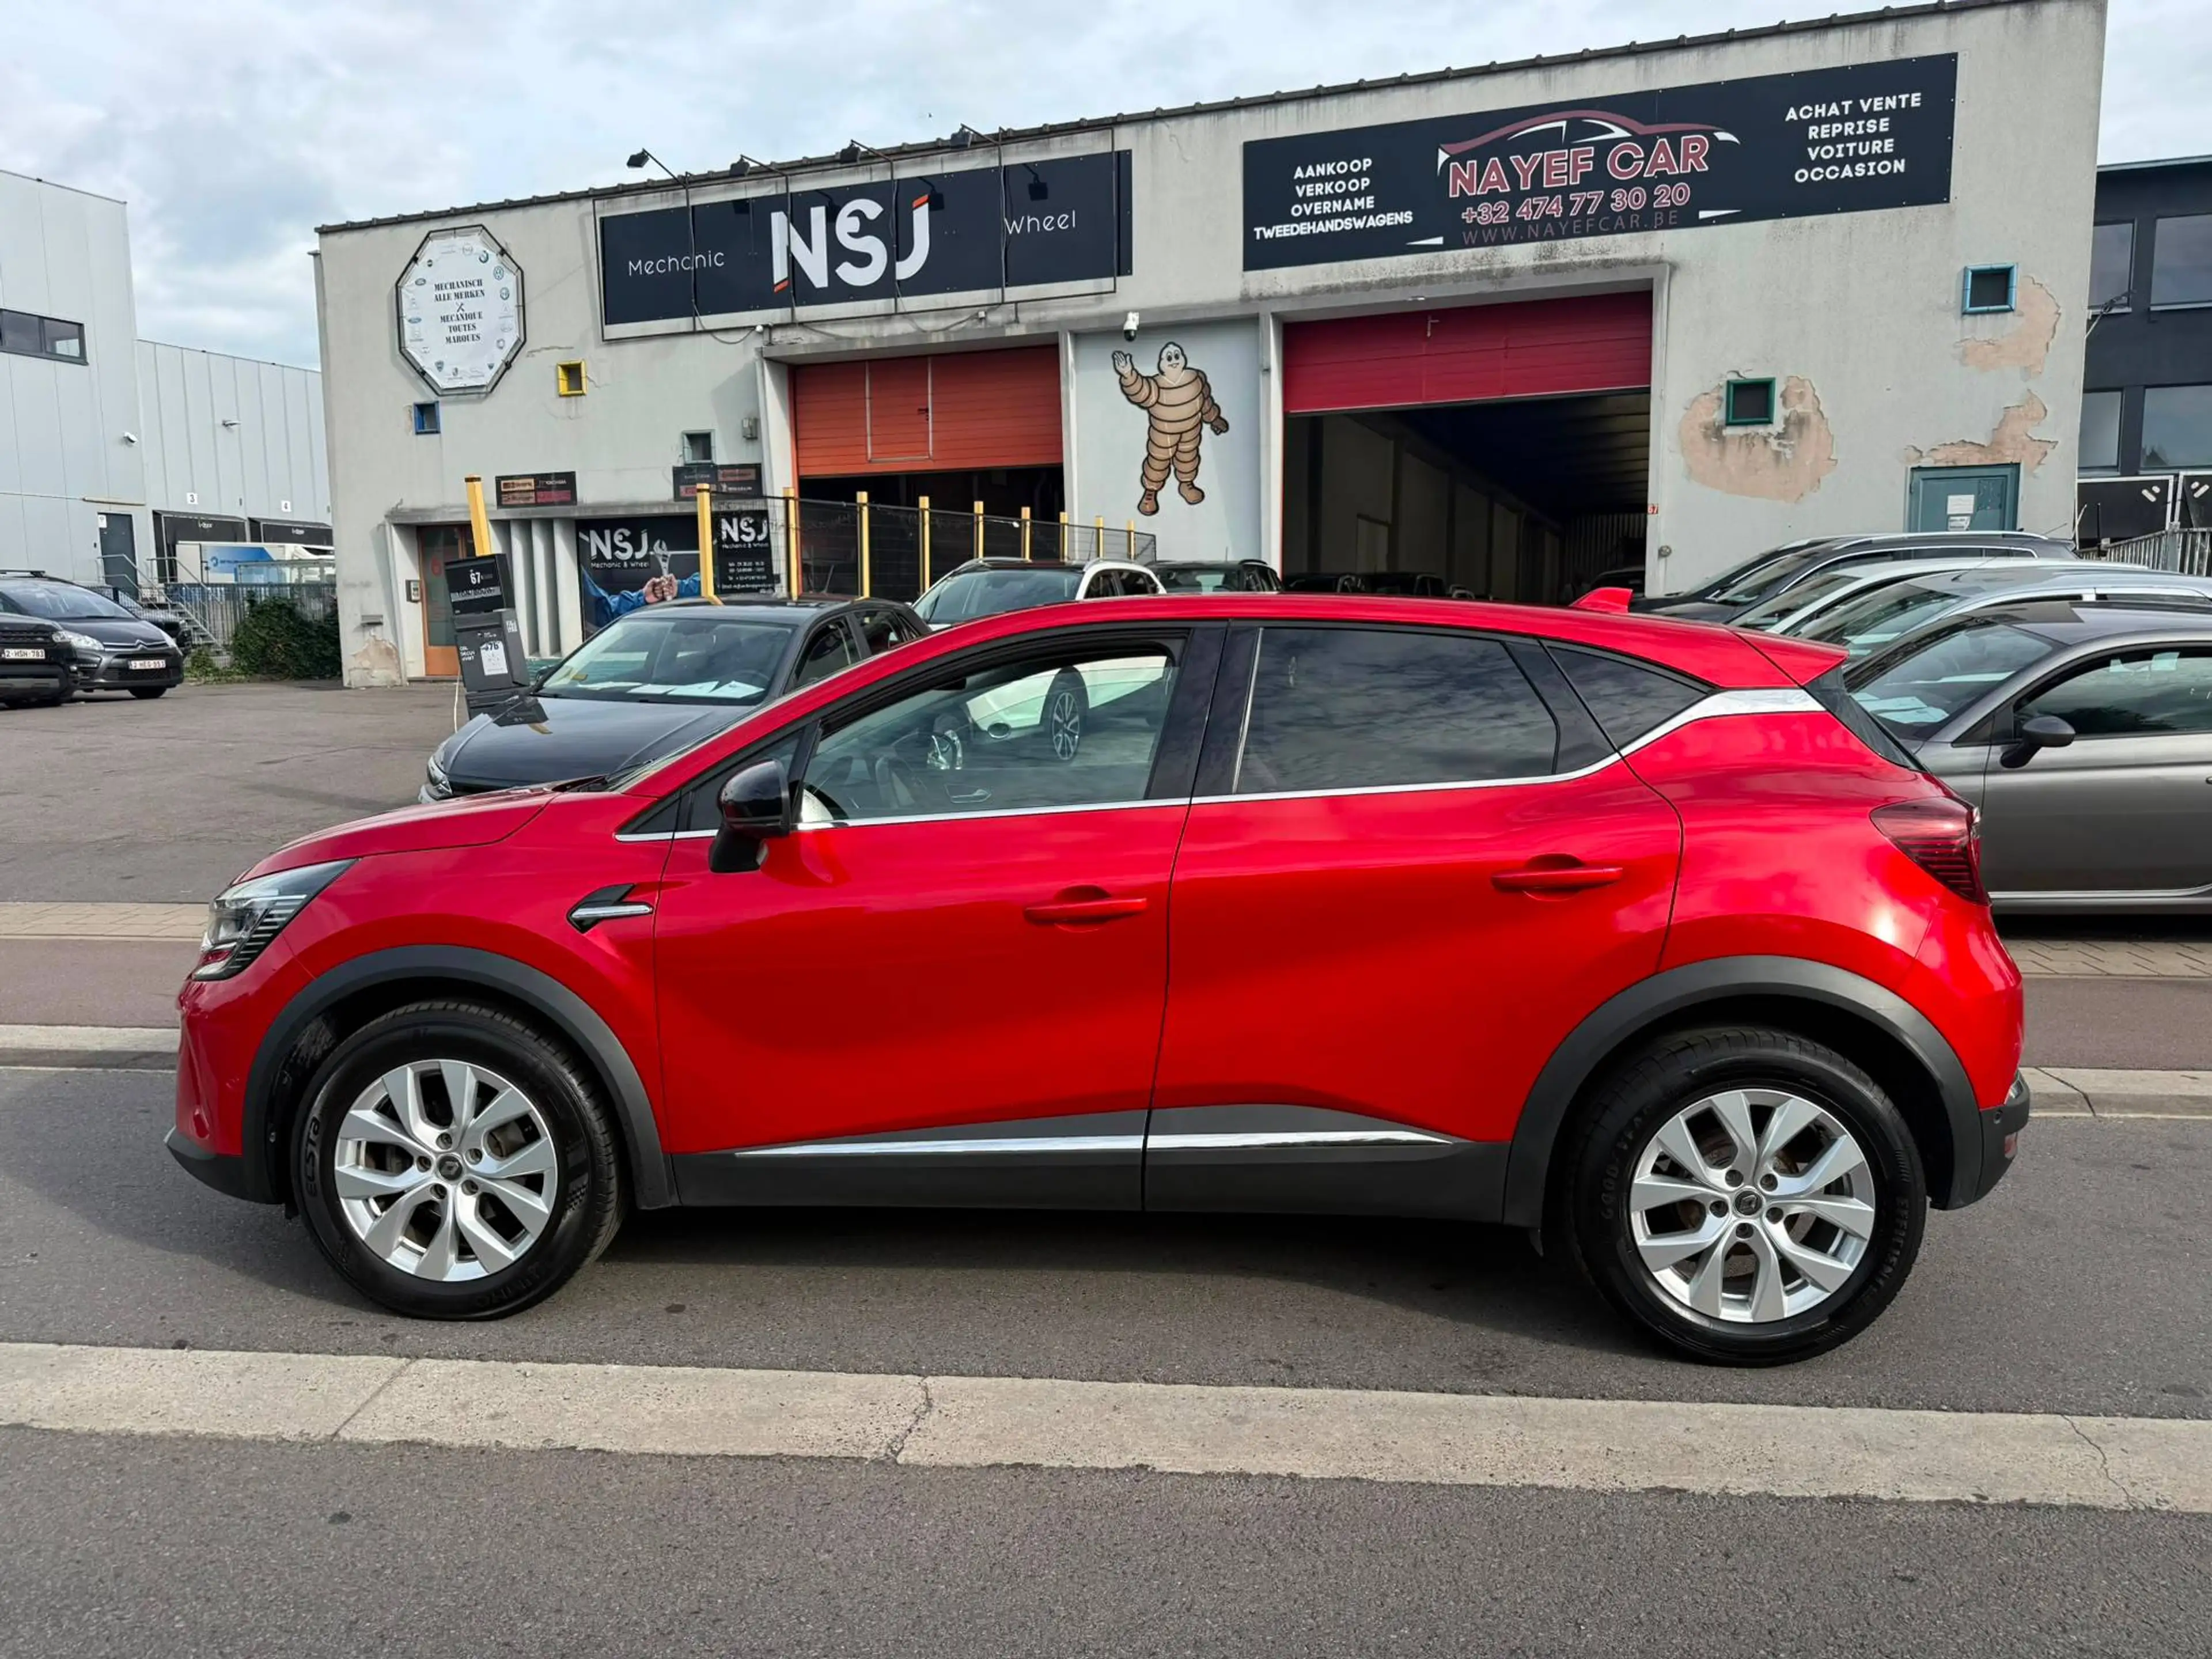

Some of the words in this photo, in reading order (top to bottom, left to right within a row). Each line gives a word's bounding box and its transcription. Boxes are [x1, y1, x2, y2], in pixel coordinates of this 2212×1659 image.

[1786, 100, 1853, 122] ACHAT
[1859, 92, 1922, 113] VENTE
[1808, 117, 1890, 140] REPRISE
[1807, 138, 1895, 161] VOITURE
[1293, 158, 1373, 180] AANKOOP
[1448, 146, 1594, 198] NAYEF
[1607, 134, 1710, 180] CAR
[1794, 158, 1906, 183] OCCASION
[1296, 177, 1371, 198] VERKOOP
[1290, 195, 1375, 218] OVERNAME
[1461, 202, 1509, 226] +32
[1516, 195, 1563, 221] 474
[1569, 191, 1604, 215] 77
[1610, 187, 1647, 212] 30
[1653, 183, 1691, 208] 20
[1253, 210, 1414, 240] TWEEDEHANDSWAGENS
[1462, 210, 1679, 246] WWW.NAYEFCAR.BE
[771, 194, 930, 293] NSJ
[434, 279, 483, 291] MECHANISCH
[434, 293, 452, 302] ALLE
[454, 290, 485, 300] MERKEN
[445, 334, 480, 344] MARQUES
[448, 323, 476, 333] TOUTES
[190, 494, 195, 503] 3
[721, 517, 768, 542] NSJ
[589, 528, 648, 560] NSJ
[469, 571, 481, 585] 67
